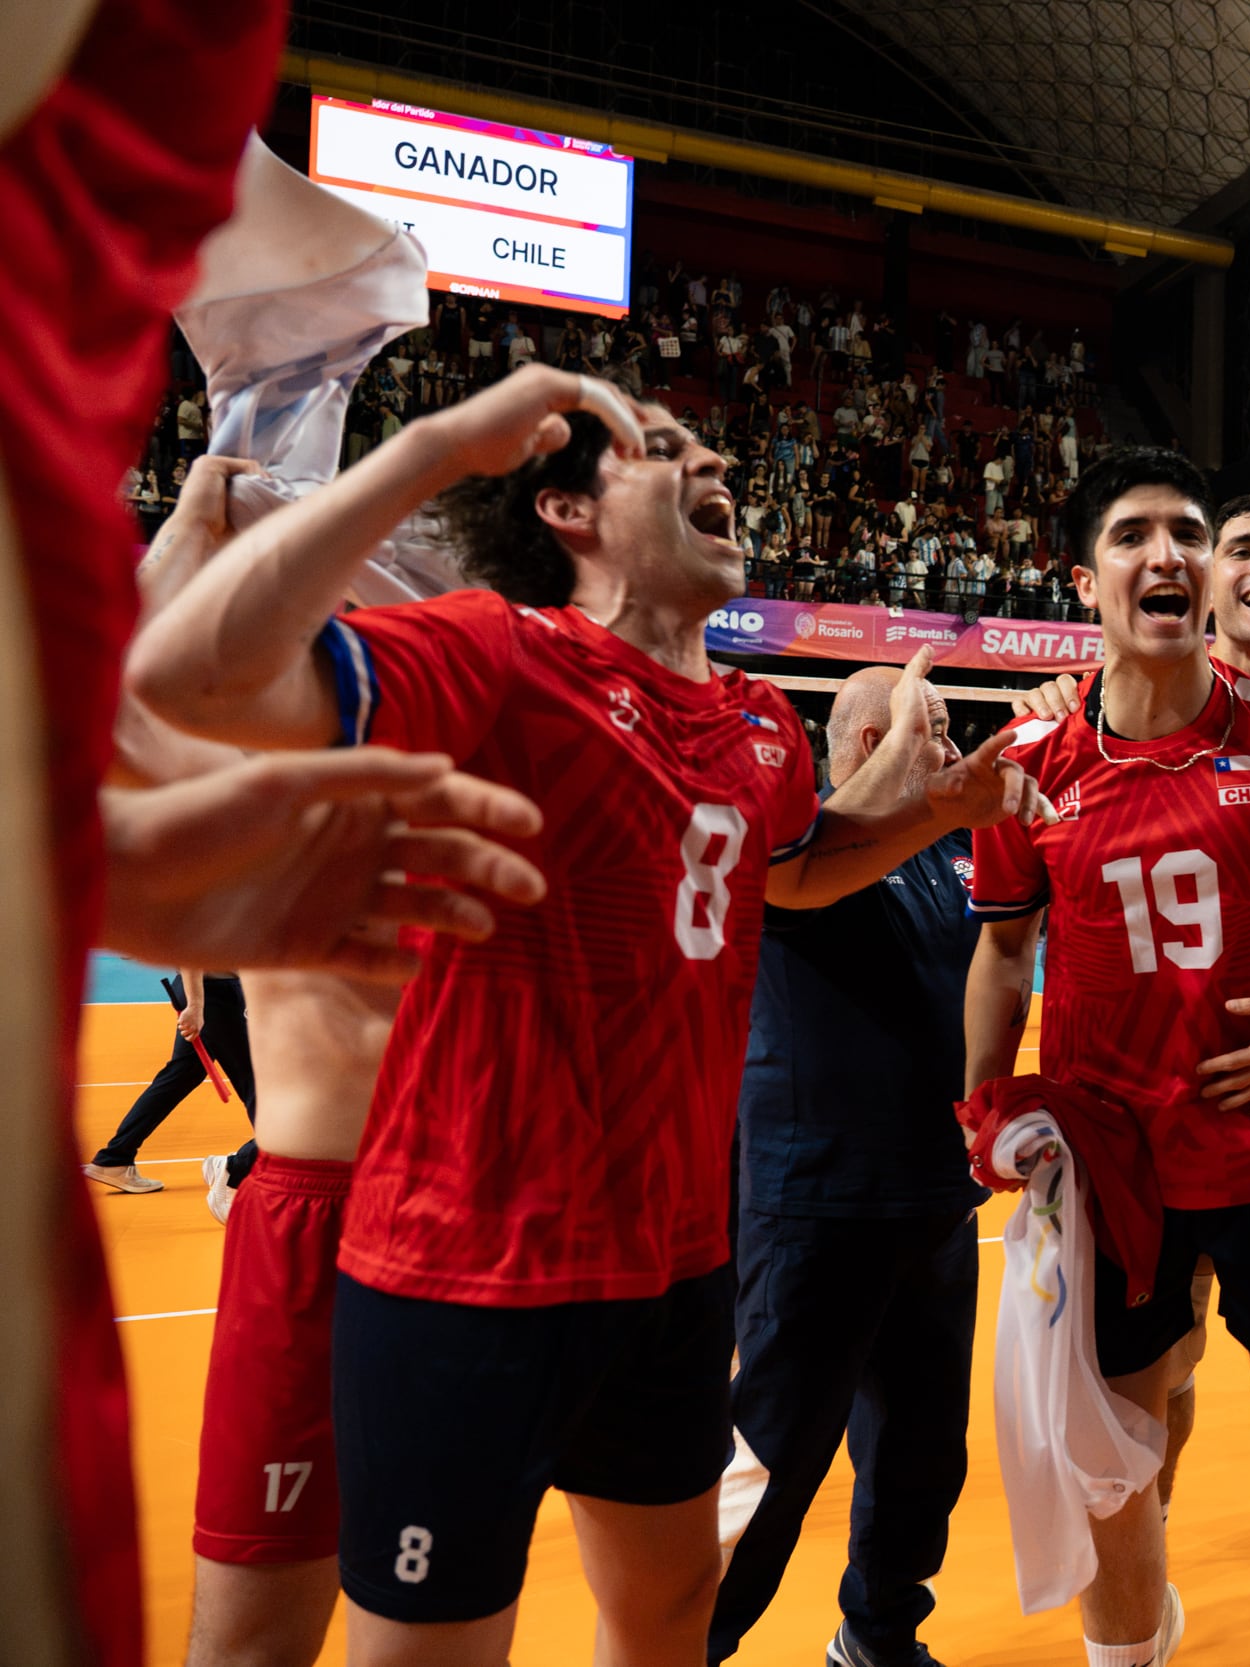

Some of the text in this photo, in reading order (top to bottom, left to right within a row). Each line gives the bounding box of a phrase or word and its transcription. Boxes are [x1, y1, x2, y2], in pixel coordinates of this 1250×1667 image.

[391, 103, 404, 113] del
[405, 105, 435, 119] Partido
[394, 141, 558, 196] GANADOR
[492, 237, 566, 269] CHILE
[818, 624, 864, 639] Rosario
[908, 626, 958, 641] Santa Fe
[981, 629, 1077, 660] SANTA
[674, 802, 749, 960] 8
[1101, 849, 1224, 974] 19
[263, 1461, 313, 1512] 17
[394, 1525, 433, 1584] 8
